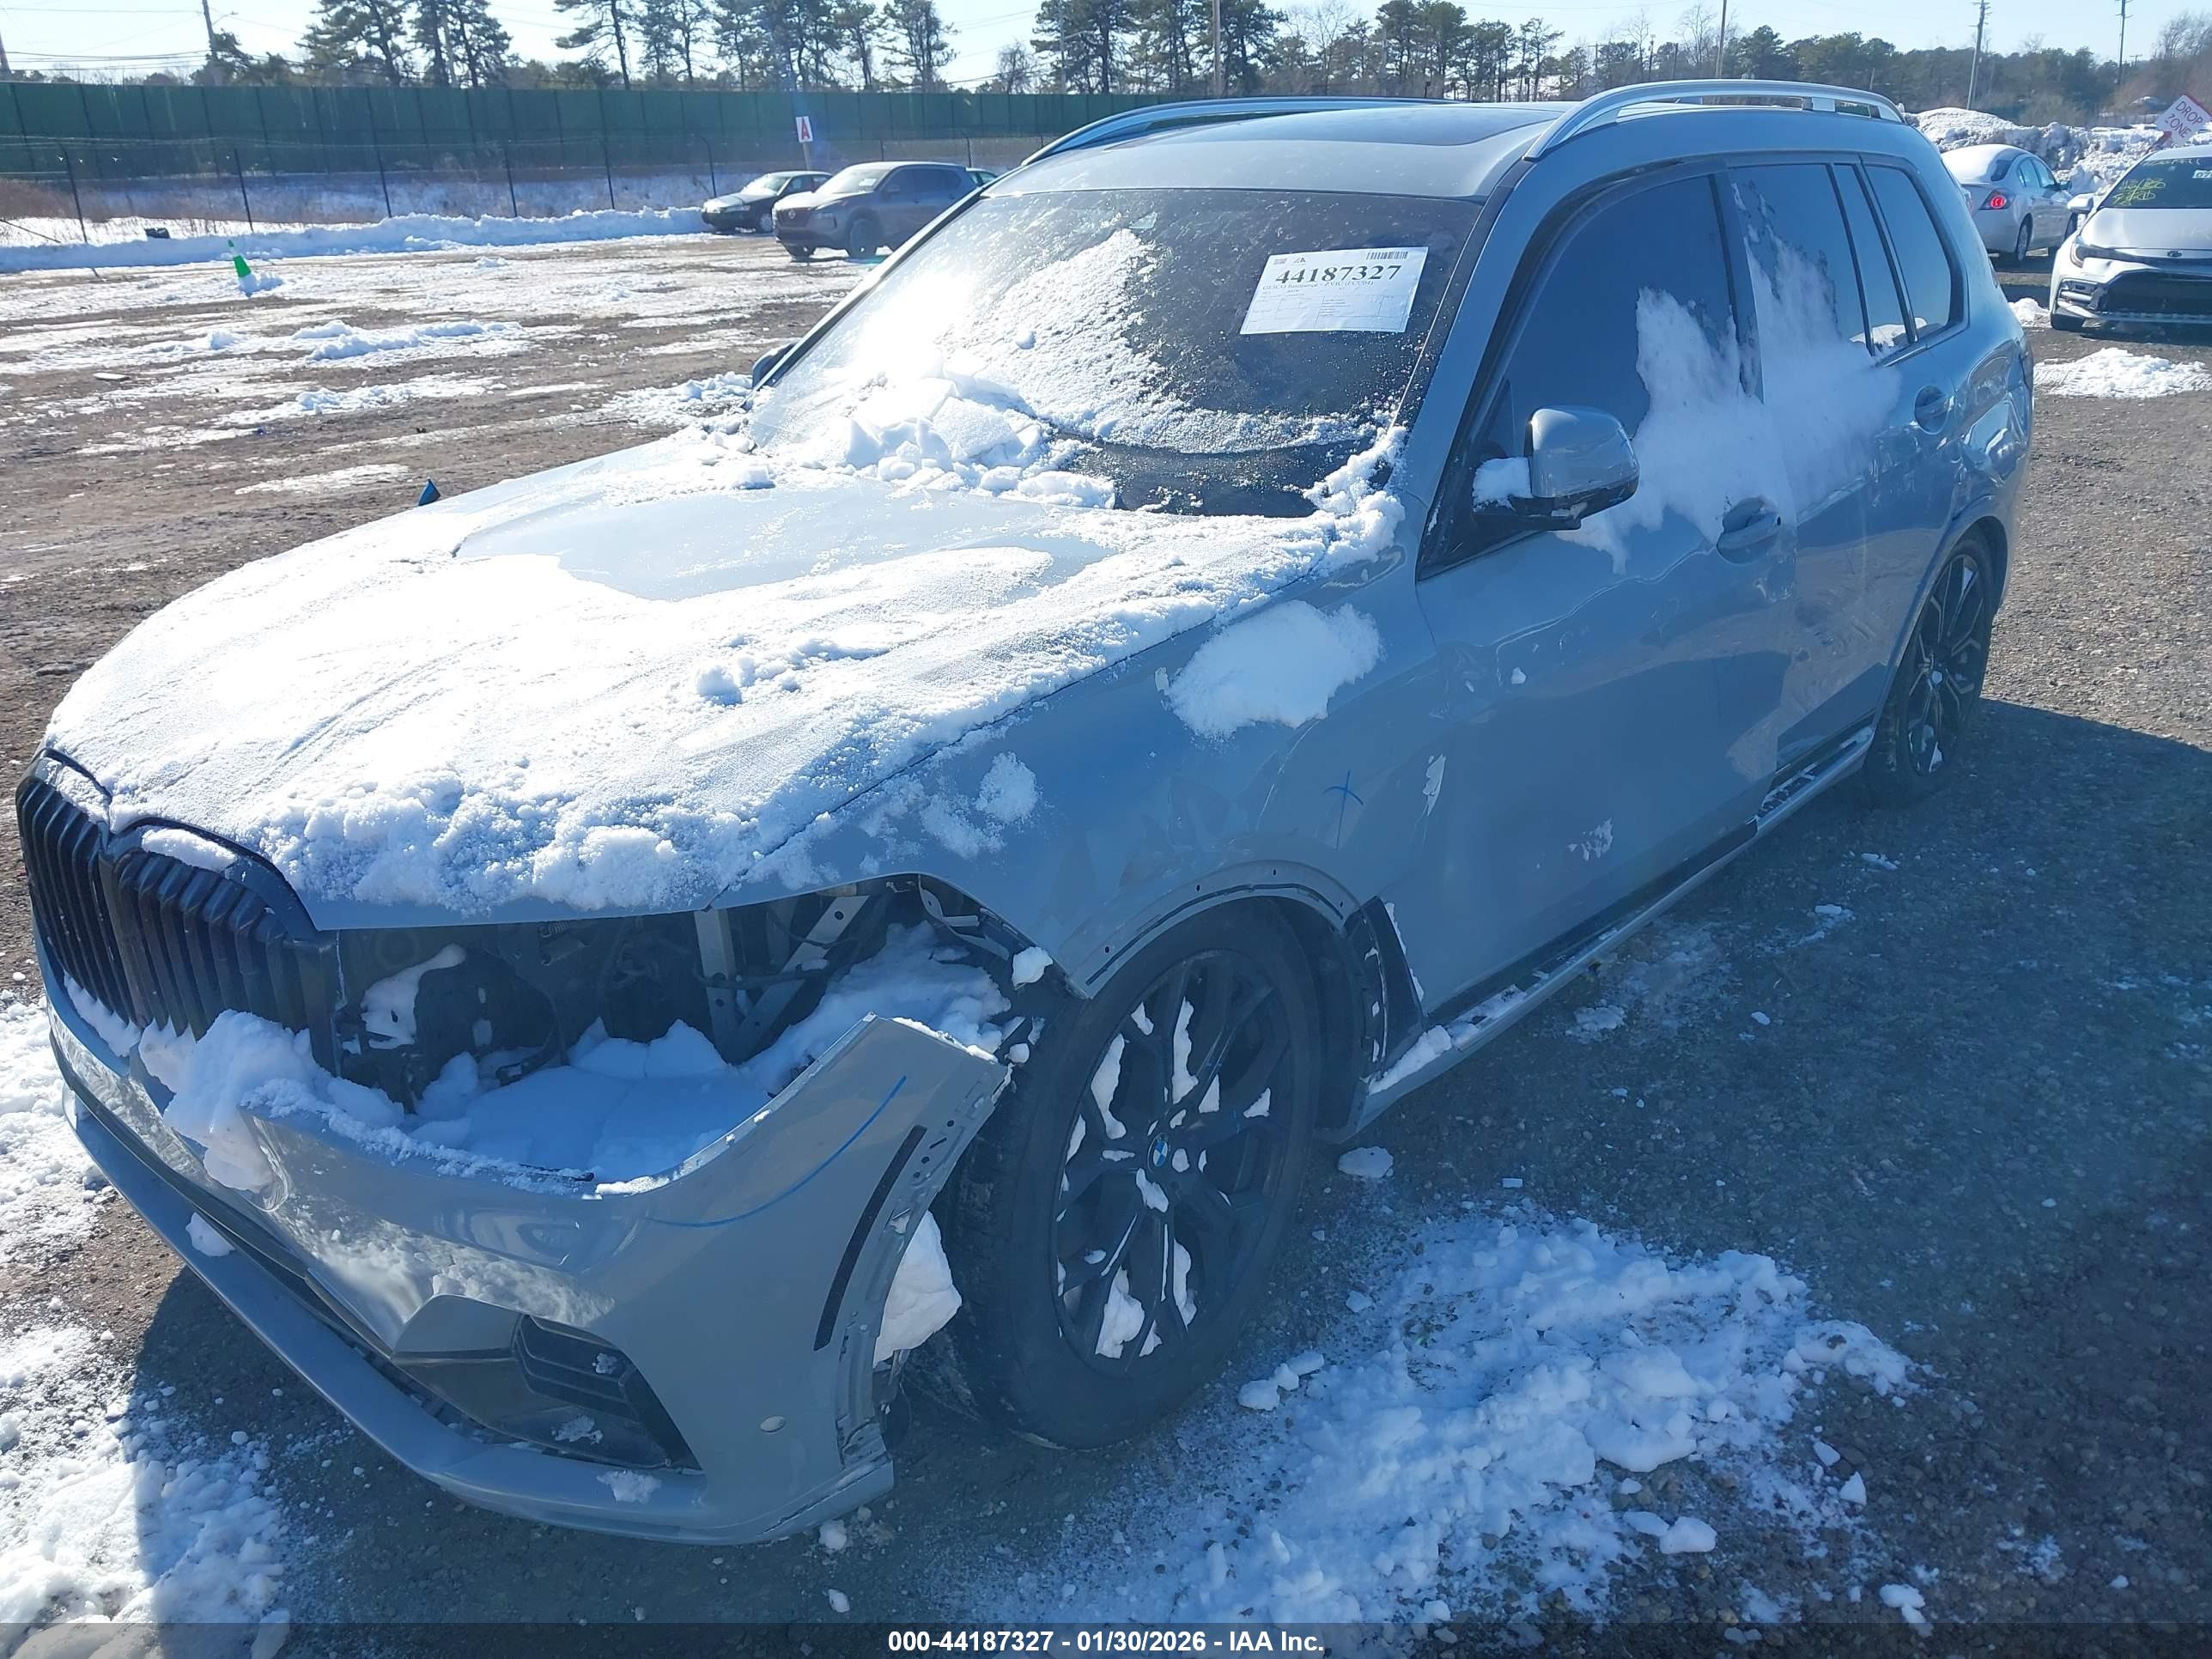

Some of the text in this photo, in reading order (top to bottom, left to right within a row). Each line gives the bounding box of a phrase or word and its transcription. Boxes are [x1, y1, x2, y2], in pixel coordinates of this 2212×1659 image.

[2175, 100, 2203, 125] DROP
[801, 118, 811, 140] A
[2164, 113, 2191, 137] ZONE
[1275, 264, 1402, 284] 44187327
